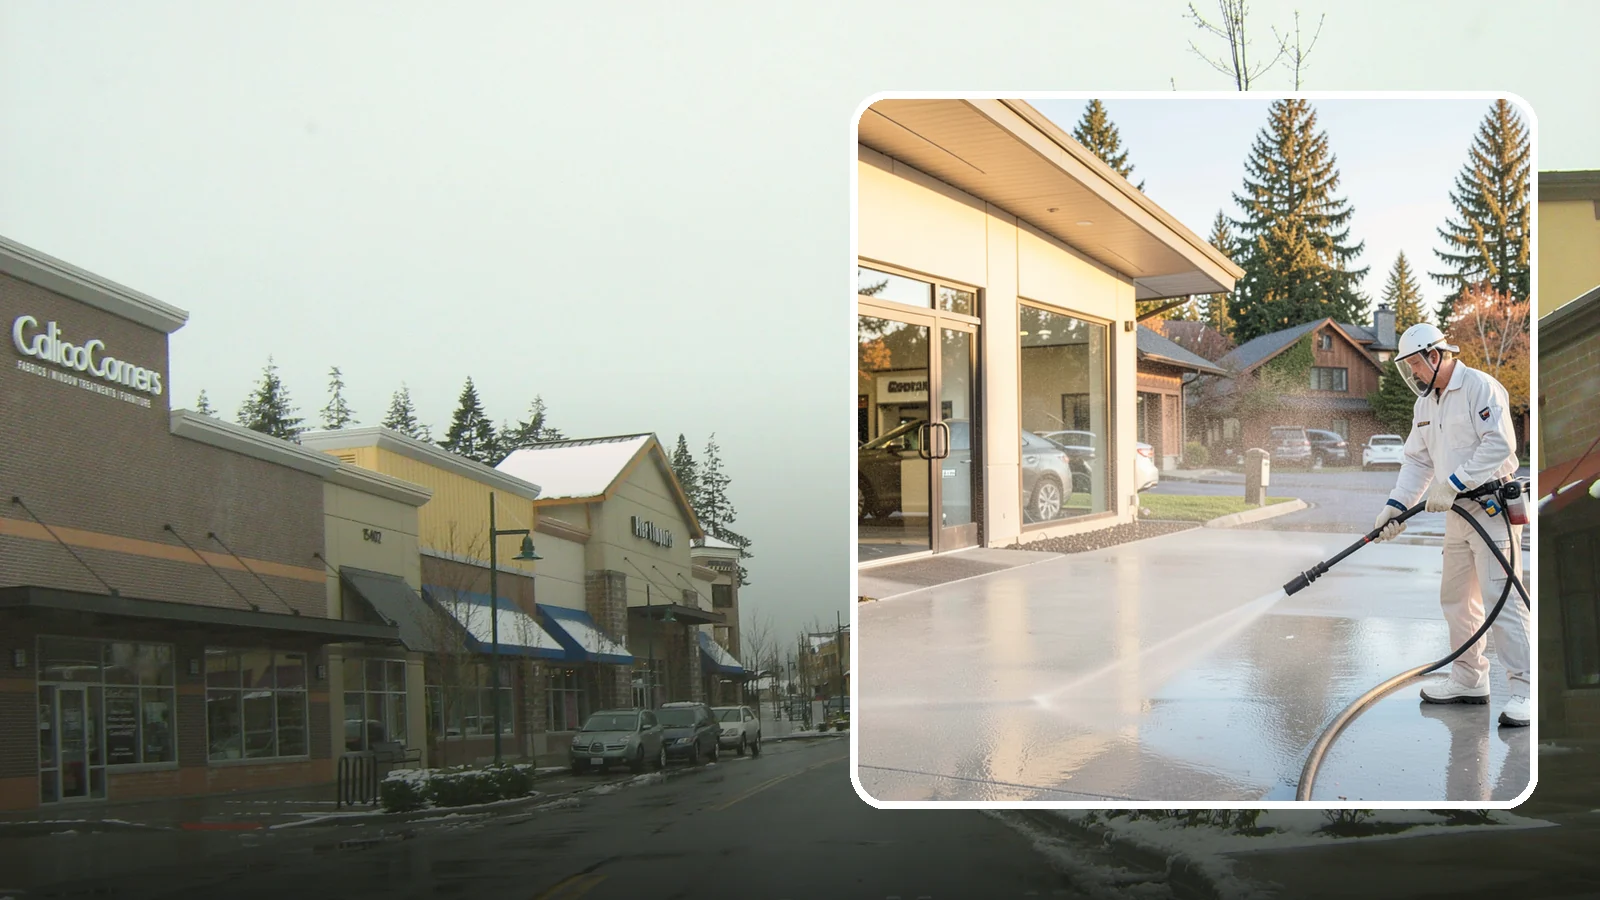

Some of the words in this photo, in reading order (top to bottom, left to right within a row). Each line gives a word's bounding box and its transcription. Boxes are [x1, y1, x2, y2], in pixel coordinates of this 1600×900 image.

[17, 360, 47, 378] FABRICS
[51, 371, 78, 387] WINDOW
[79, 378, 116, 398] TREATMENTS
